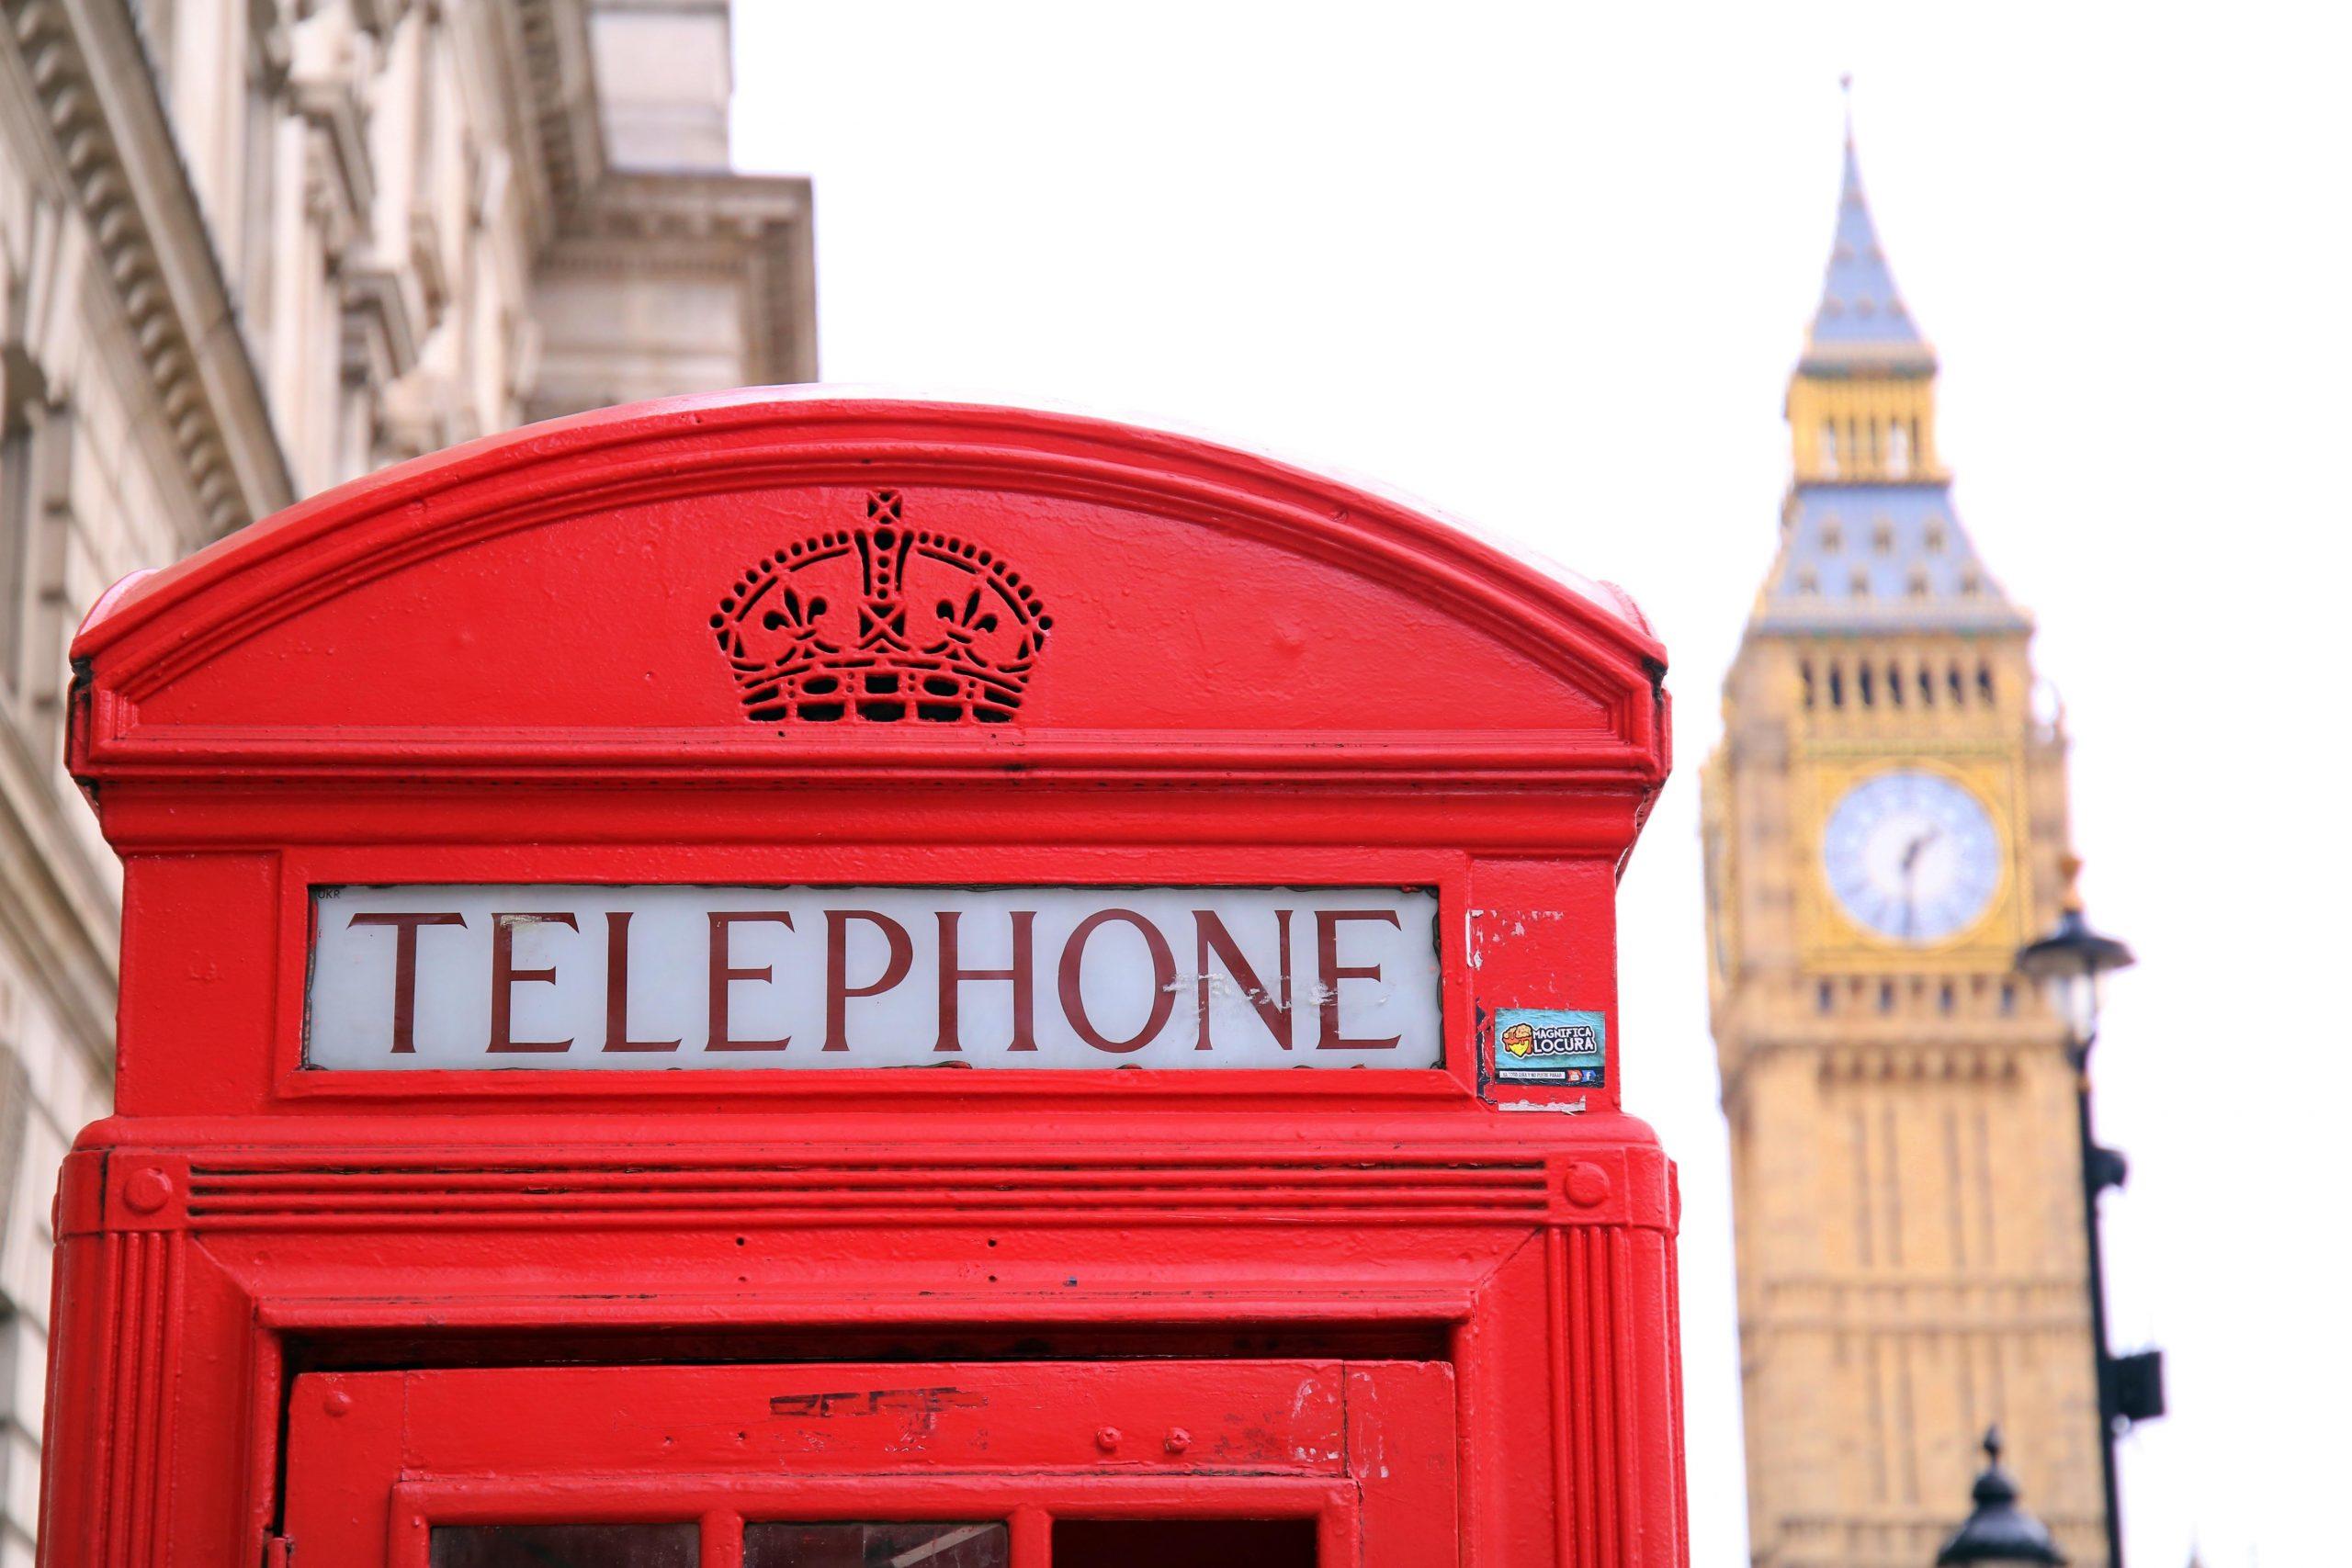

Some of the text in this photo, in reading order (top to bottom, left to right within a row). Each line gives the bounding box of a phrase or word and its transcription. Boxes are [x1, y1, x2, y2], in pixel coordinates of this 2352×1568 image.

[345, 908, 1402, 1054] TELEPHONE
[1532, 1027, 1591, 1039] MAGNIFICA
[1533, 1037, 1594, 1052] LOCURA
